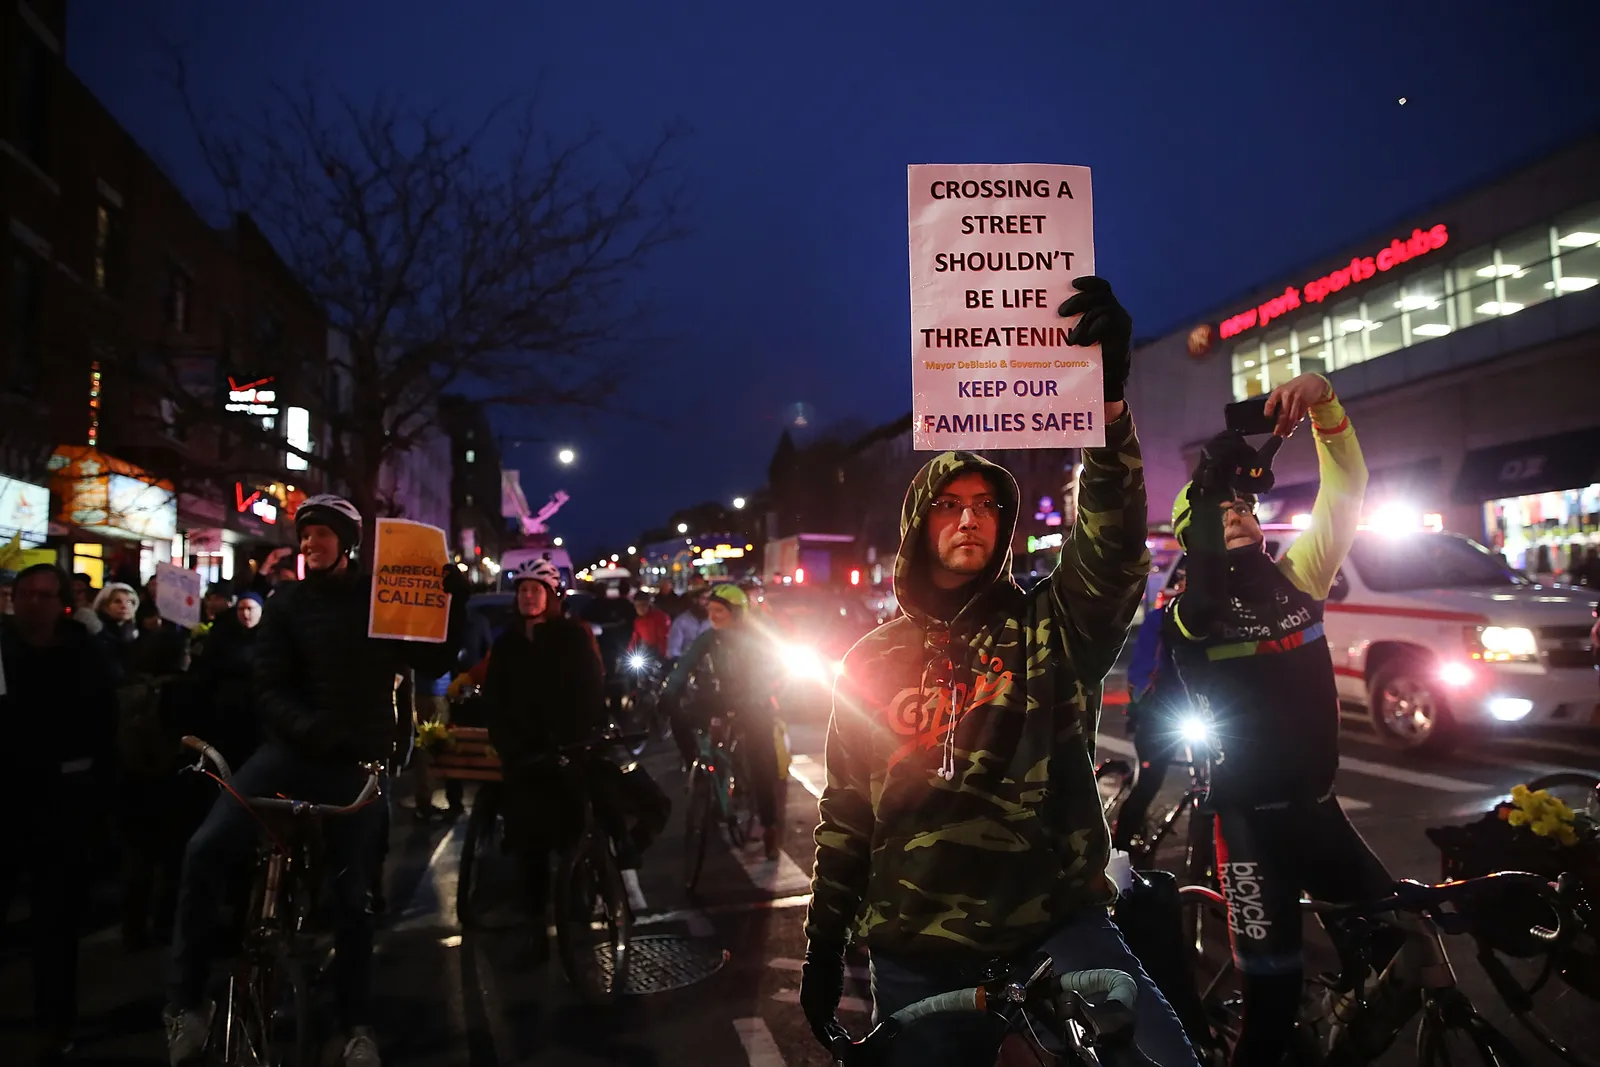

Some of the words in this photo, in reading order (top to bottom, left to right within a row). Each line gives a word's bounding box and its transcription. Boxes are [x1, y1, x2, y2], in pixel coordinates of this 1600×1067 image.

[931, 180, 1050, 199] CROSSING
[1057, 181, 1073, 199] A
[962, 215, 1046, 234] STREET
[935, 250, 1075, 272] SHOULDN'T
[1304, 257, 1376, 302] sports
[1376, 224, 1449, 271] clubs
[966, 289, 994, 308] BE
[1003, 289, 1047, 308] LIFE
[921, 327, 1074, 348] THREATENIN
[925, 361, 955, 371] Mayor
[1000, 360, 1007, 368] &
[1010, 360, 1051, 369] Governor
[1054, 360, 1089, 368] Cuomo:
[959, 381, 1007, 398] KEEP
[1014, 380, 1058, 397] OUR
[925, 413, 1025, 433] FAMILIES
[1032, 412, 1093, 431] SAFE!
[377, 589, 446, 608] CALLES
[1231, 862, 1272, 940] bicycle
